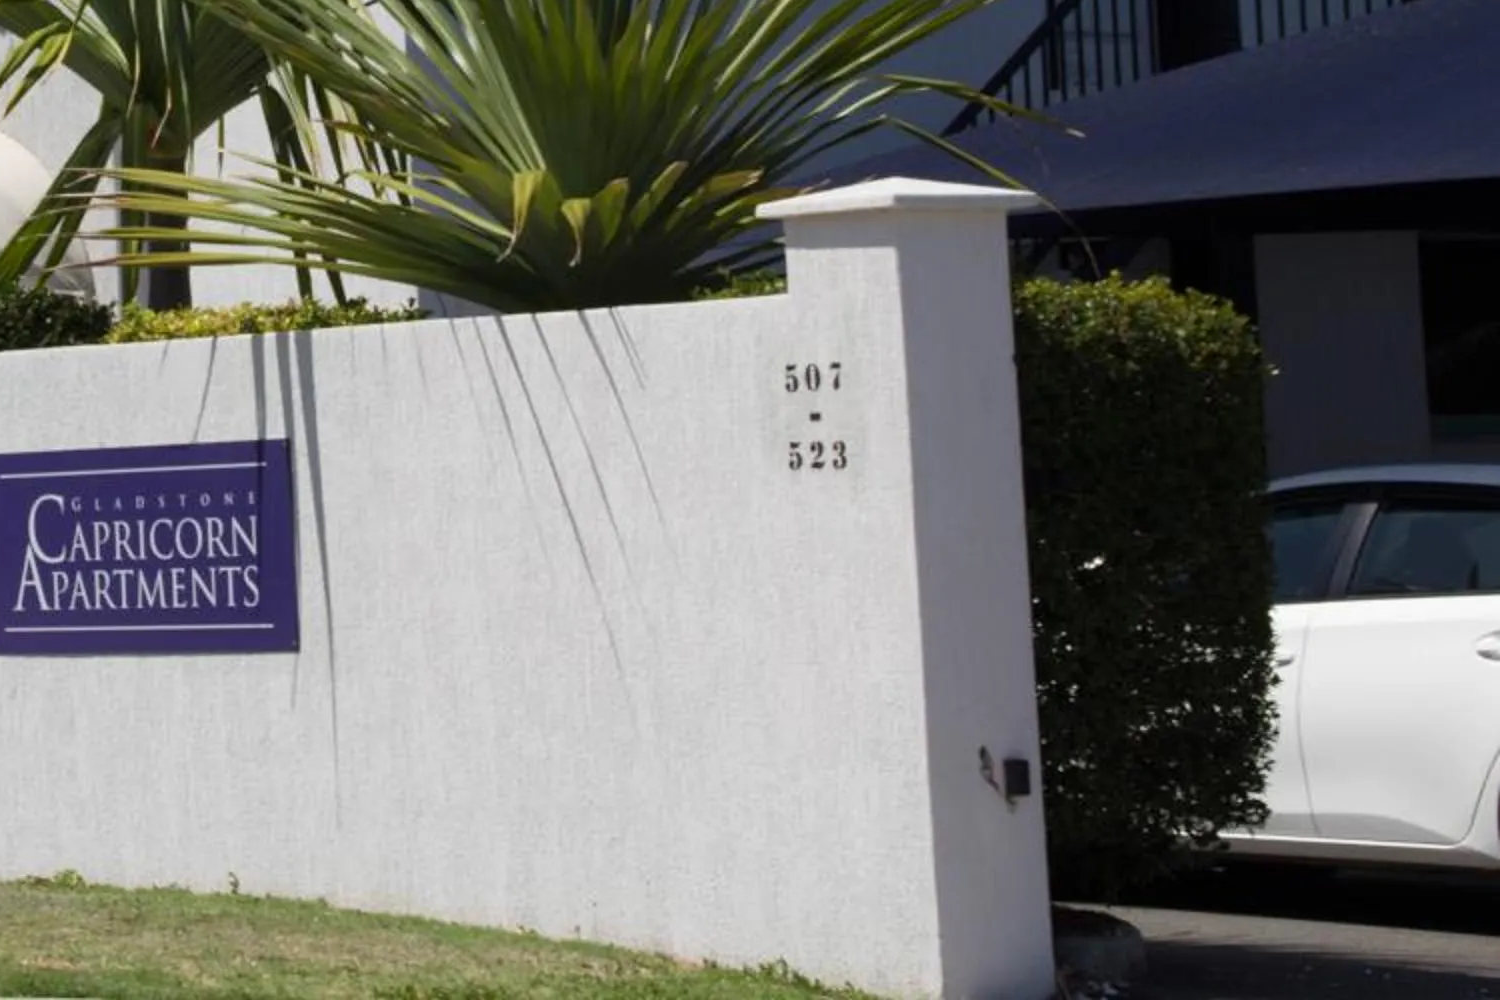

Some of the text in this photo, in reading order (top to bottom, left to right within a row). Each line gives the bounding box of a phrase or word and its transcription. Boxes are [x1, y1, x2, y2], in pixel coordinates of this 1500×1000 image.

[785, 361, 841, 392] 507
[789, 440, 847, 470] 523
[71, 490, 257, 512] GLADSTONE
[28, 493, 258, 564] CAPRICORN
[12, 543, 260, 612] APARTMENTS
